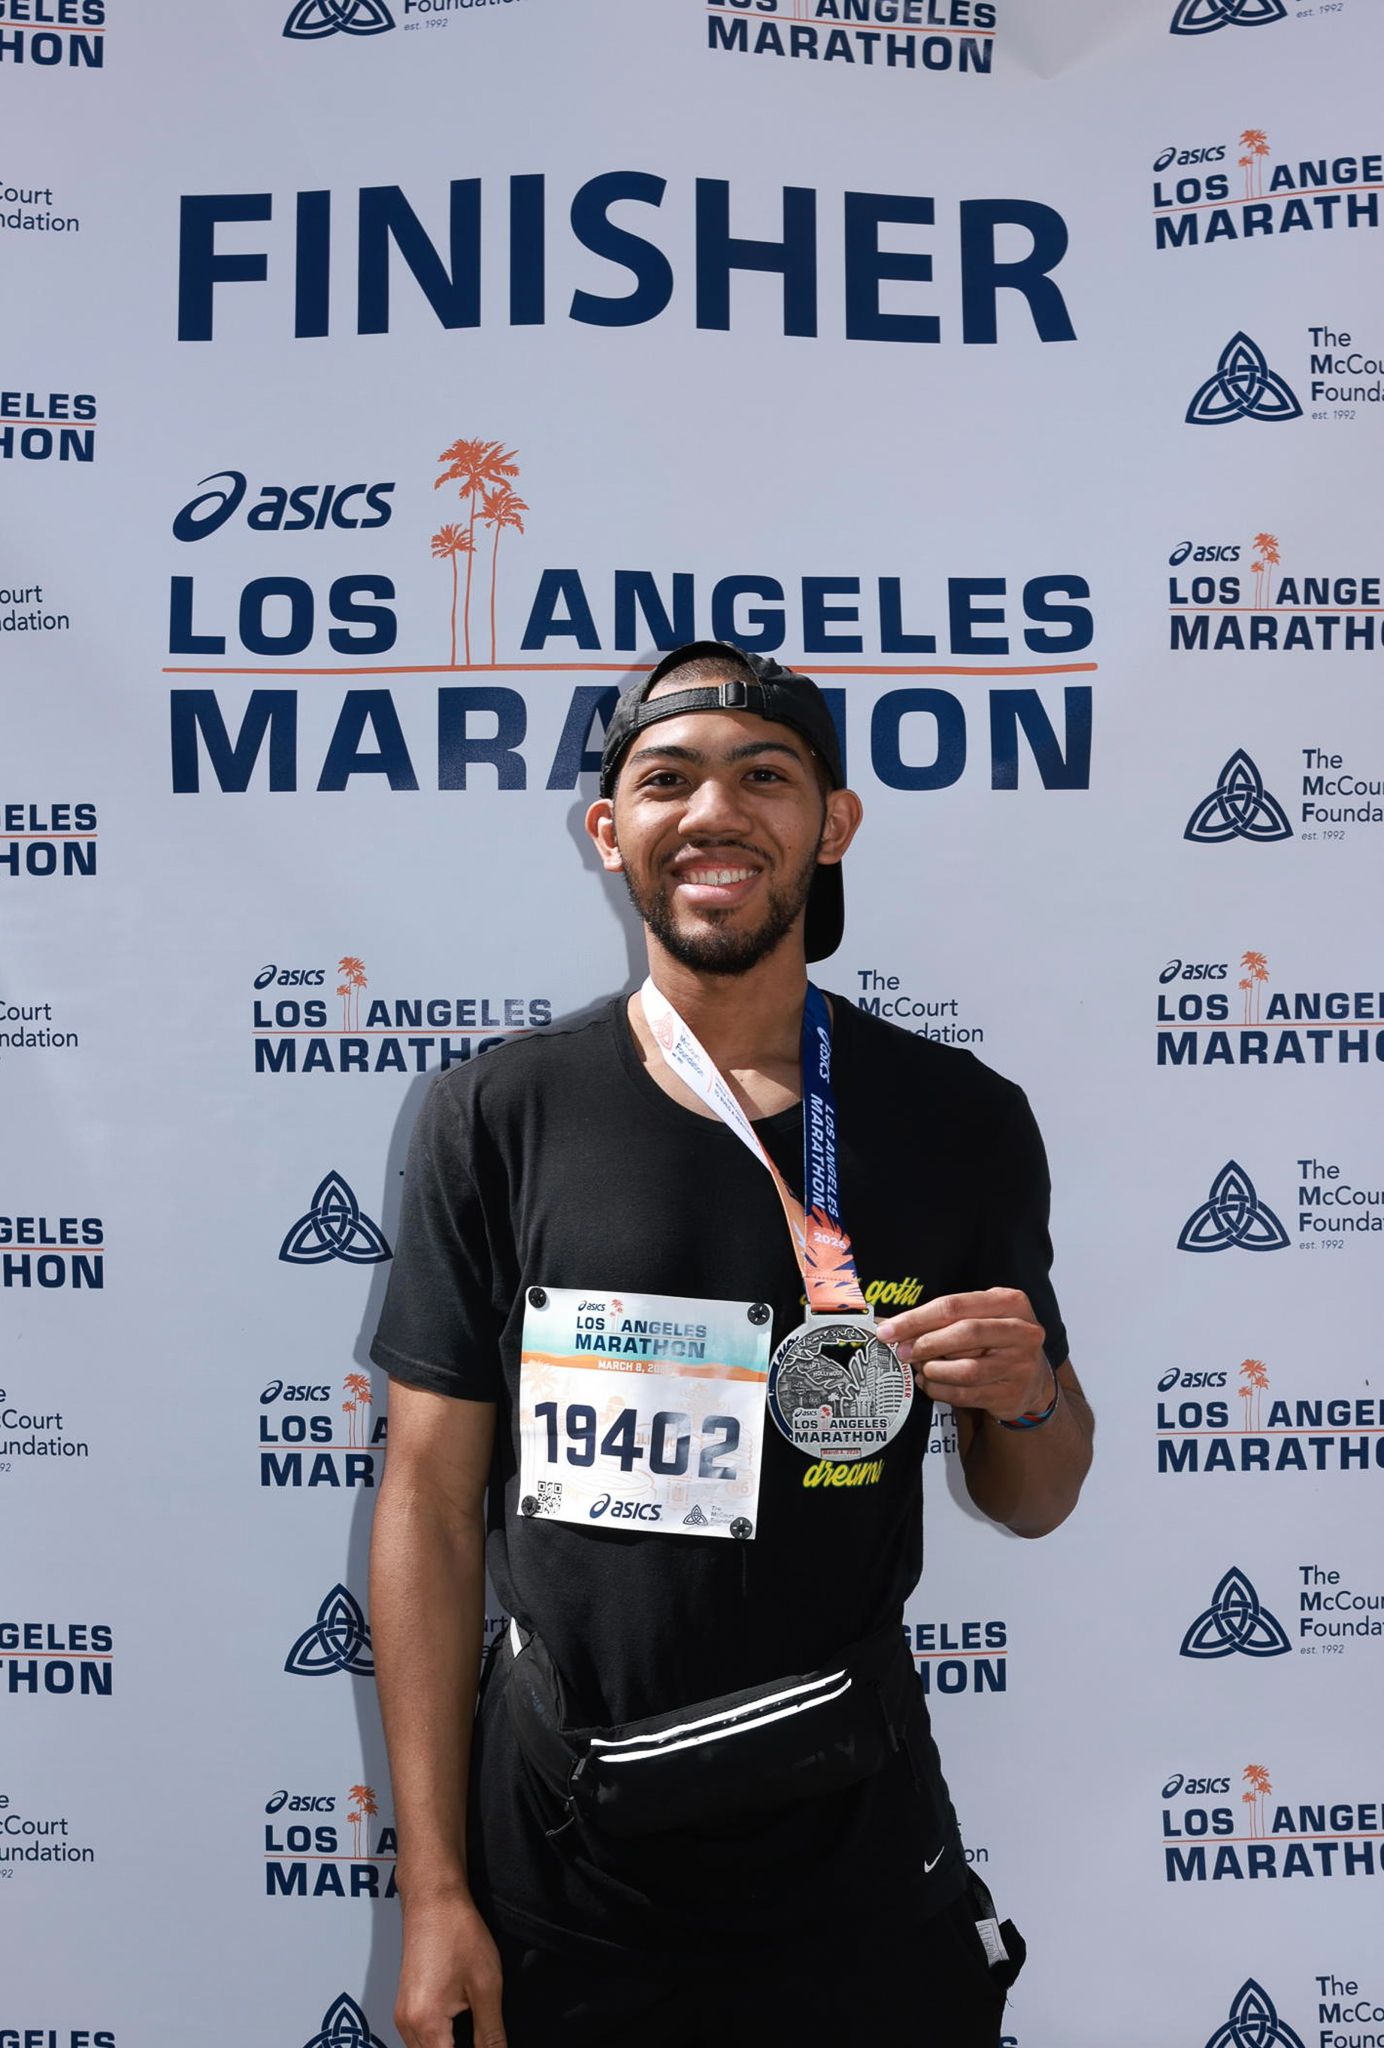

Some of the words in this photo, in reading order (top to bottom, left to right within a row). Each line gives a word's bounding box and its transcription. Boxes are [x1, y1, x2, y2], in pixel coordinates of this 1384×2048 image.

[0, 0, 104, 25] ELES
[815, 0, 996, 29] ANGELES
[708, 15, 993, 74] MARATHON
[0, 181, 52, 205] ourt
[1153, 174, 1229, 208] LOS
[1269, 155, 1383, 192] ANGE
[178, 171, 1078, 344] FINISHER
[1308, 326, 1352, 347] The
[1312, 380, 1384, 401] Found
[1333, 409, 1356, 420] 1992
[1169, 577, 1240, 605] LOS
[0, 609, 69, 631] dation
[169, 575, 398, 657] LOS
[519, 568, 1094, 656] ANGELES
[1170, 615, 1384, 651] MARATH
[1302, 747, 1343, 769] The
[1303, 775, 1384, 796] McCou
[0, 803, 97, 832] ELES
[1322, 830, 1345, 840] 1992
[857, 969, 900, 991] The
[254, 1000, 327, 1028] LOS
[366, 998, 552, 1028] ANGELES
[858, 996, 958, 1018] McCourt
[1157, 994, 1229, 1021] LOS
[1266, 992, 1384, 1020] ANGE
[1157, 1029, 1384, 1066] MARATH
[825, 1104, 836, 1140] LOS
[811, 1093, 826, 1210] MARATHON
[826, 1138, 839, 1218] ANGELES
[1297, 1158, 1341, 1179] The
[1299, 1210, 1384, 1232] Founda
[814, 1232, 847, 1249] 2026
[1321, 1239, 1344, 1249] 1992
[864, 1277, 923, 1306] gotta
[576, 1316, 606, 1330] LOS
[621, 1319, 707, 1338] ANGELES
[575, 1333, 706, 1359] MARATHON
[598, 1360, 634, 1371] MARCH
[0, 1408, 63, 1430] Court
[794, 1420, 819, 1429] LOS
[830, 1419, 888, 1429] ANGELES
[1157, 1401, 1229, 1429] LOS
[1267, 1399, 1384, 1427] ANGE
[259, 1415, 333, 1443] LOS
[535, 1401, 741, 1481] 19402
[795, 1431, 887, 1443] MARATHON
[1158, 1437, 1384, 1473] MARATH
[1299, 1564, 1341, 1585] The
[1301, 1615, 1384, 1637] Founda
[1322, 1644, 1345, 1654] 1992
[0, 1660, 112, 1696] HON
[0, 1815, 68, 1836] Court
[1162, 1808, 1234, 1837] LOS
[265, 1824, 338, 1853] LOS
[1165, 1841, 1384, 1882] MARATH
[1315, 1974, 1359, 1996] The
